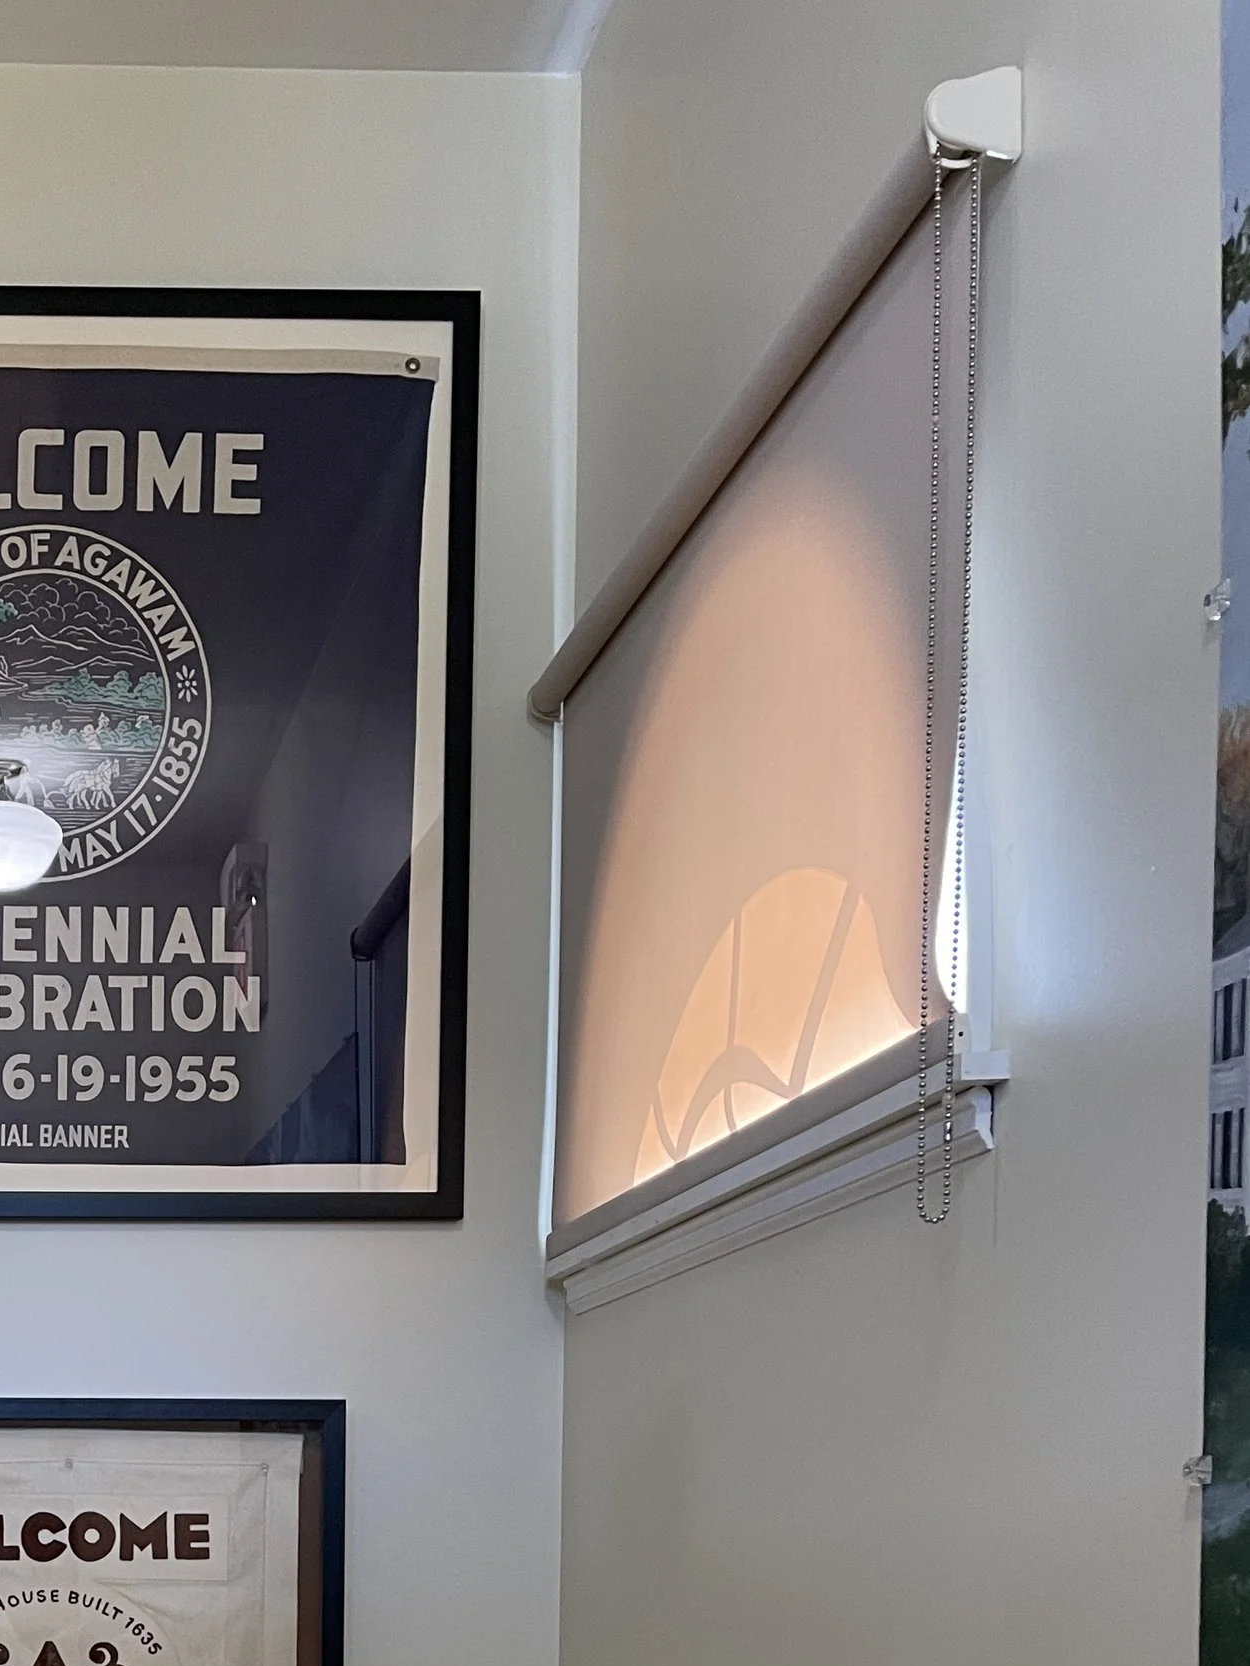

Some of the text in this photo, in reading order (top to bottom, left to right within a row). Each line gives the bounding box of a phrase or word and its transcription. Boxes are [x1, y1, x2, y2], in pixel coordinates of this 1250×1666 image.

[0, 532, 51, 569] OF
[54, 535, 197, 662] AGAWAM
[58, 819, 123, 873] MAY
[39, 1123, 130, 1150] BANNER
[67, 1590, 123, 1621] BUILT
[124, 1616, 163, 1655] 1635
